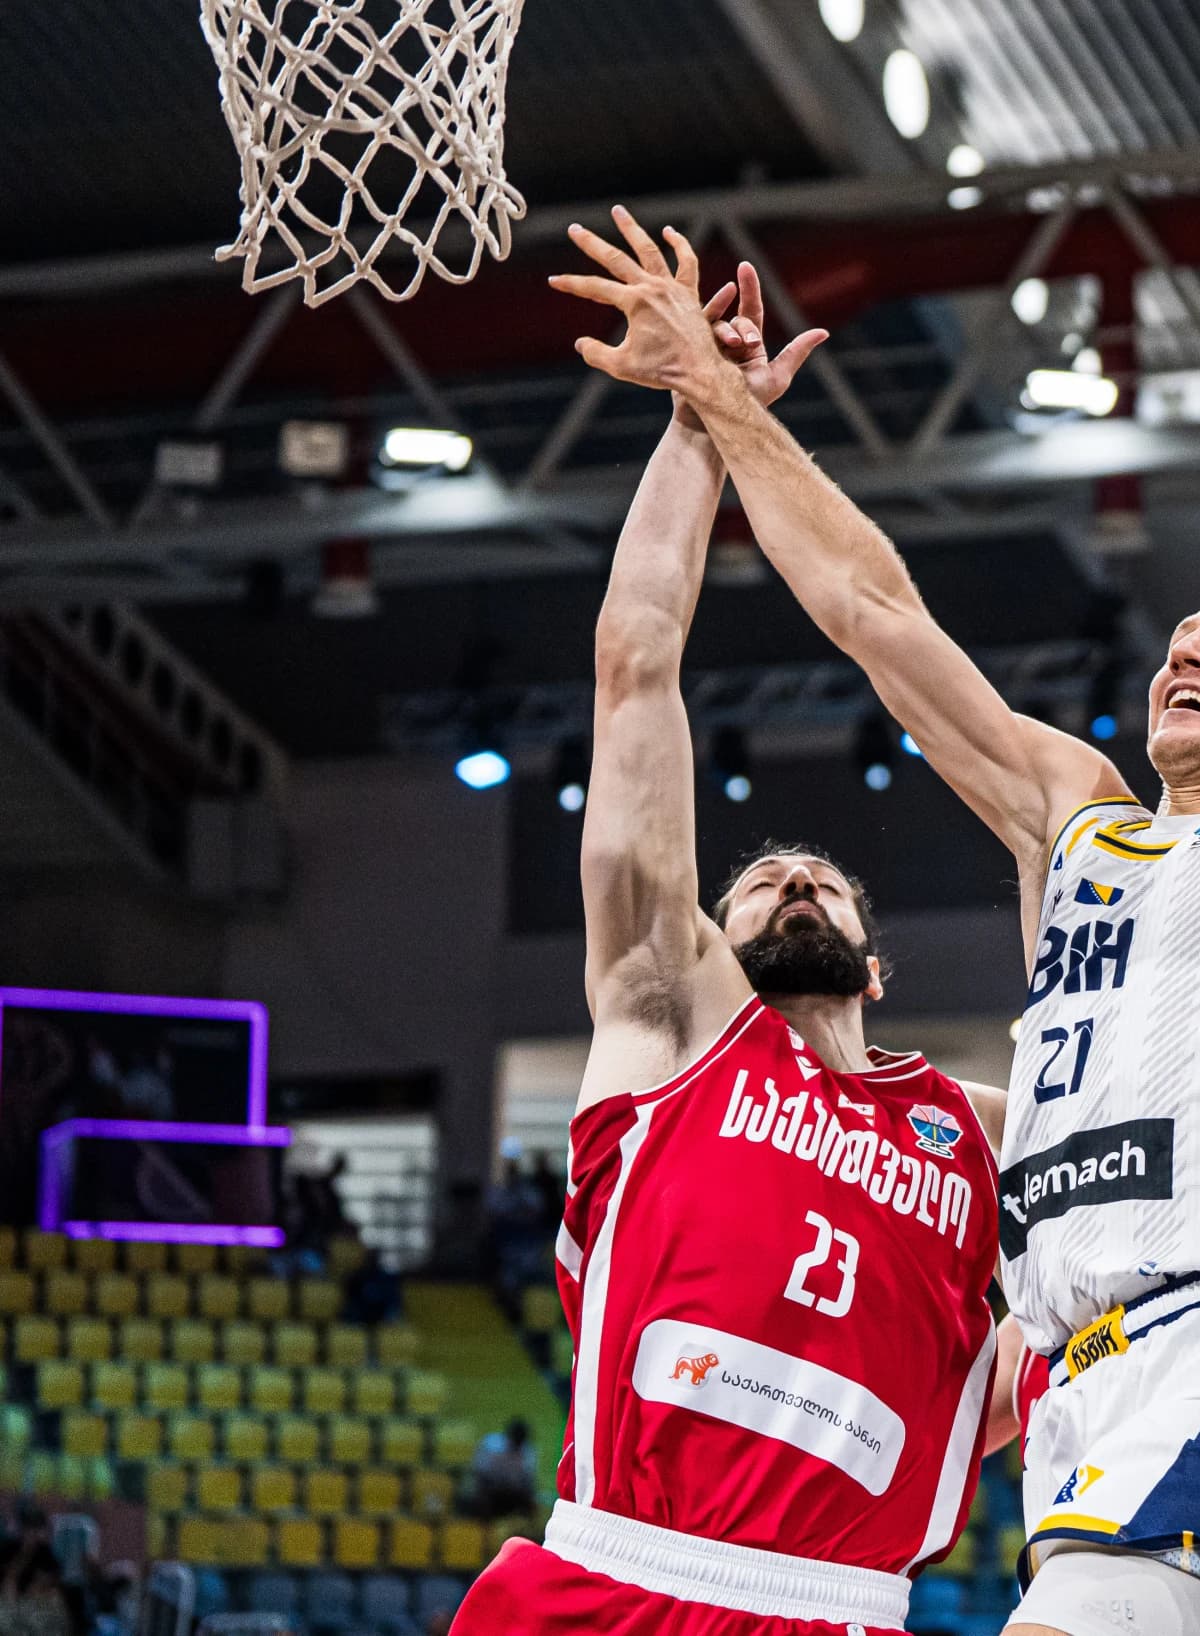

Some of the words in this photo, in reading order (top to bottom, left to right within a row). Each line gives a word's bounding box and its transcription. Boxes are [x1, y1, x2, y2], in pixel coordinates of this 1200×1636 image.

[1025, 918, 1135, 1011] BIH
[1034, 1017, 1094, 1104] 21
[1002, 1139, 1146, 1224] tlemach
[783, 1210, 860, 1318] 23
